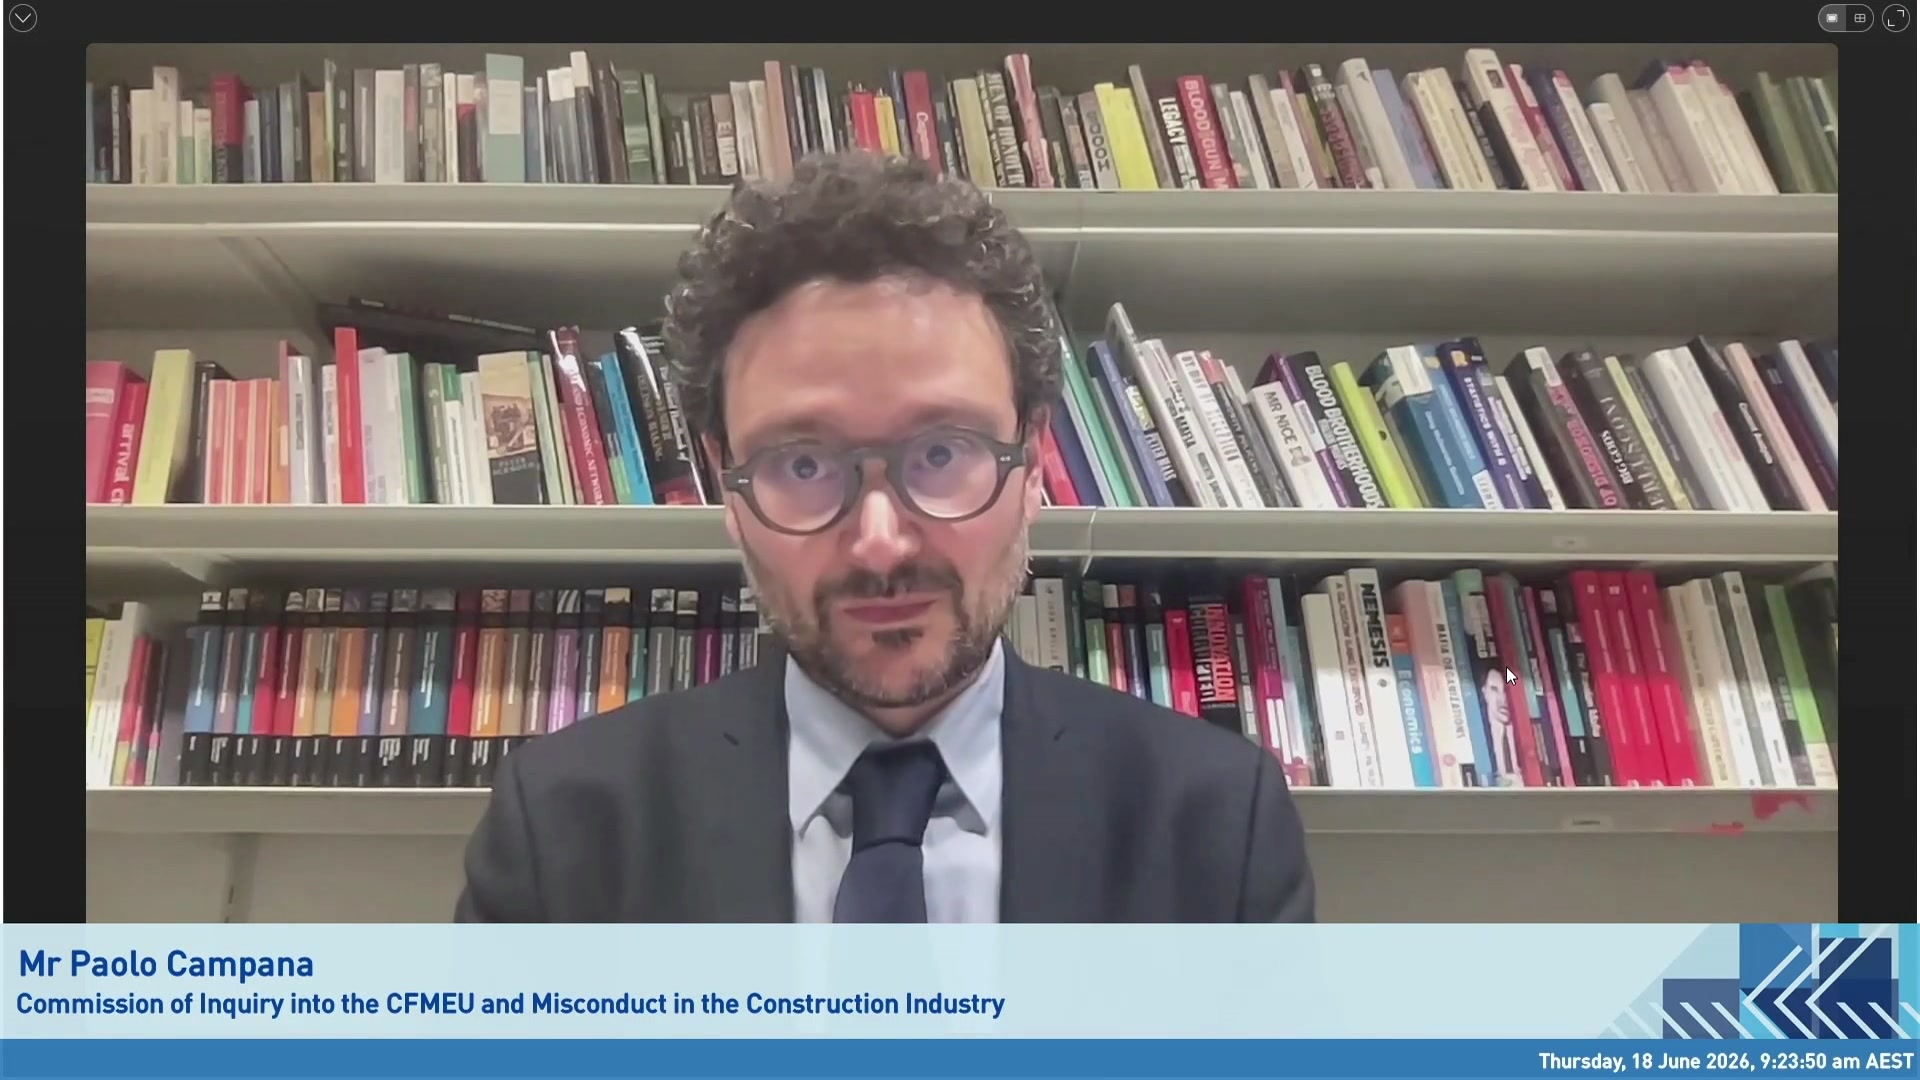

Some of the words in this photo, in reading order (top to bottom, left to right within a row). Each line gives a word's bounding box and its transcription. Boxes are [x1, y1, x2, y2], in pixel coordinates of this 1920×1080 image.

[1158, 96, 1187, 146] LEGACY
[1183, 79, 1210, 135] BLOOD
[1201, 136, 1222, 172] GUN
[1180, 355, 1196, 369] BY
[576, 407, 595, 458] ECONOMIC
[1264, 391, 1280, 413] MR
[1274, 413, 1299, 445] NICE
[1305, 364, 1336, 410] BLOOD
[1324, 408, 1384, 509] BROTHERHOODS
[1464, 377, 1491, 430] STATISTICS
[1486, 431, 1506, 457] WITH
[113, 423, 135, 483] arrival
[1144, 432, 1166, 462] PETER
[1156, 457, 1177, 481] MAAS
[1602, 429, 1624, 463] GODS
[1616, 463, 1633, 485] BIG
[1335, 582, 1343, 590] A
[1337, 593, 1350, 638] GLASGOW
[1360, 583, 1390, 669] NEMESIS
[1436, 623, 1449, 654] MAFIA
[1192, 609, 1216, 702] CORRUPTED
[1208, 604, 1236, 702] INNOVATION
[1397, 669, 1422, 755] Economics
[1442, 656, 1466, 739] ORGANIZATIONS
